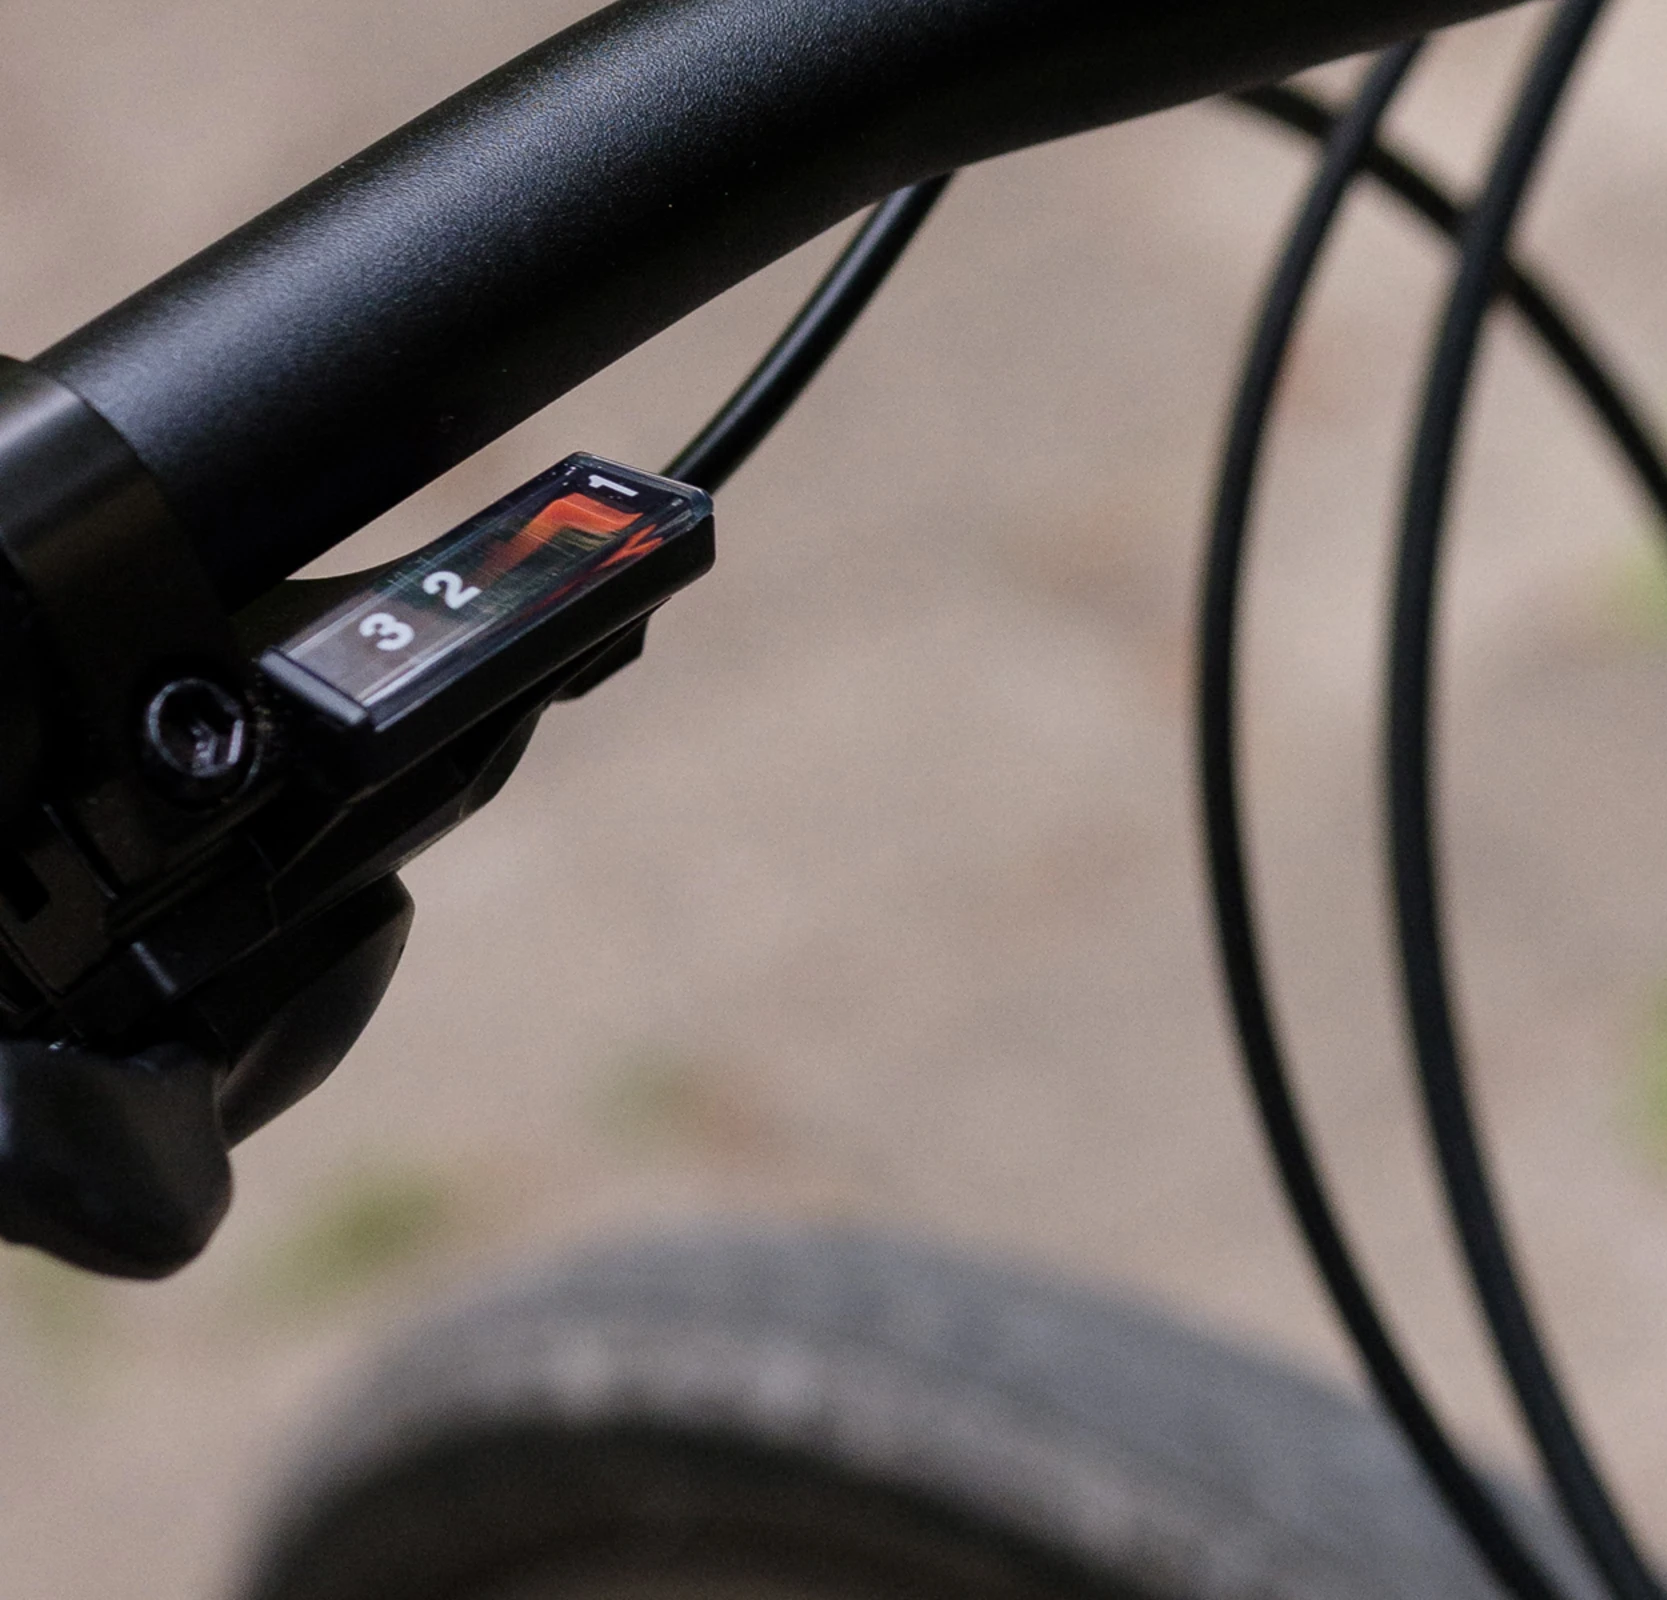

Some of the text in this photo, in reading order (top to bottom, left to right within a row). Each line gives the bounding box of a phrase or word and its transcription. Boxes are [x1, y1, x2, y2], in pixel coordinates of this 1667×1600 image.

[360, 475, 639, 651] 3 2 1
